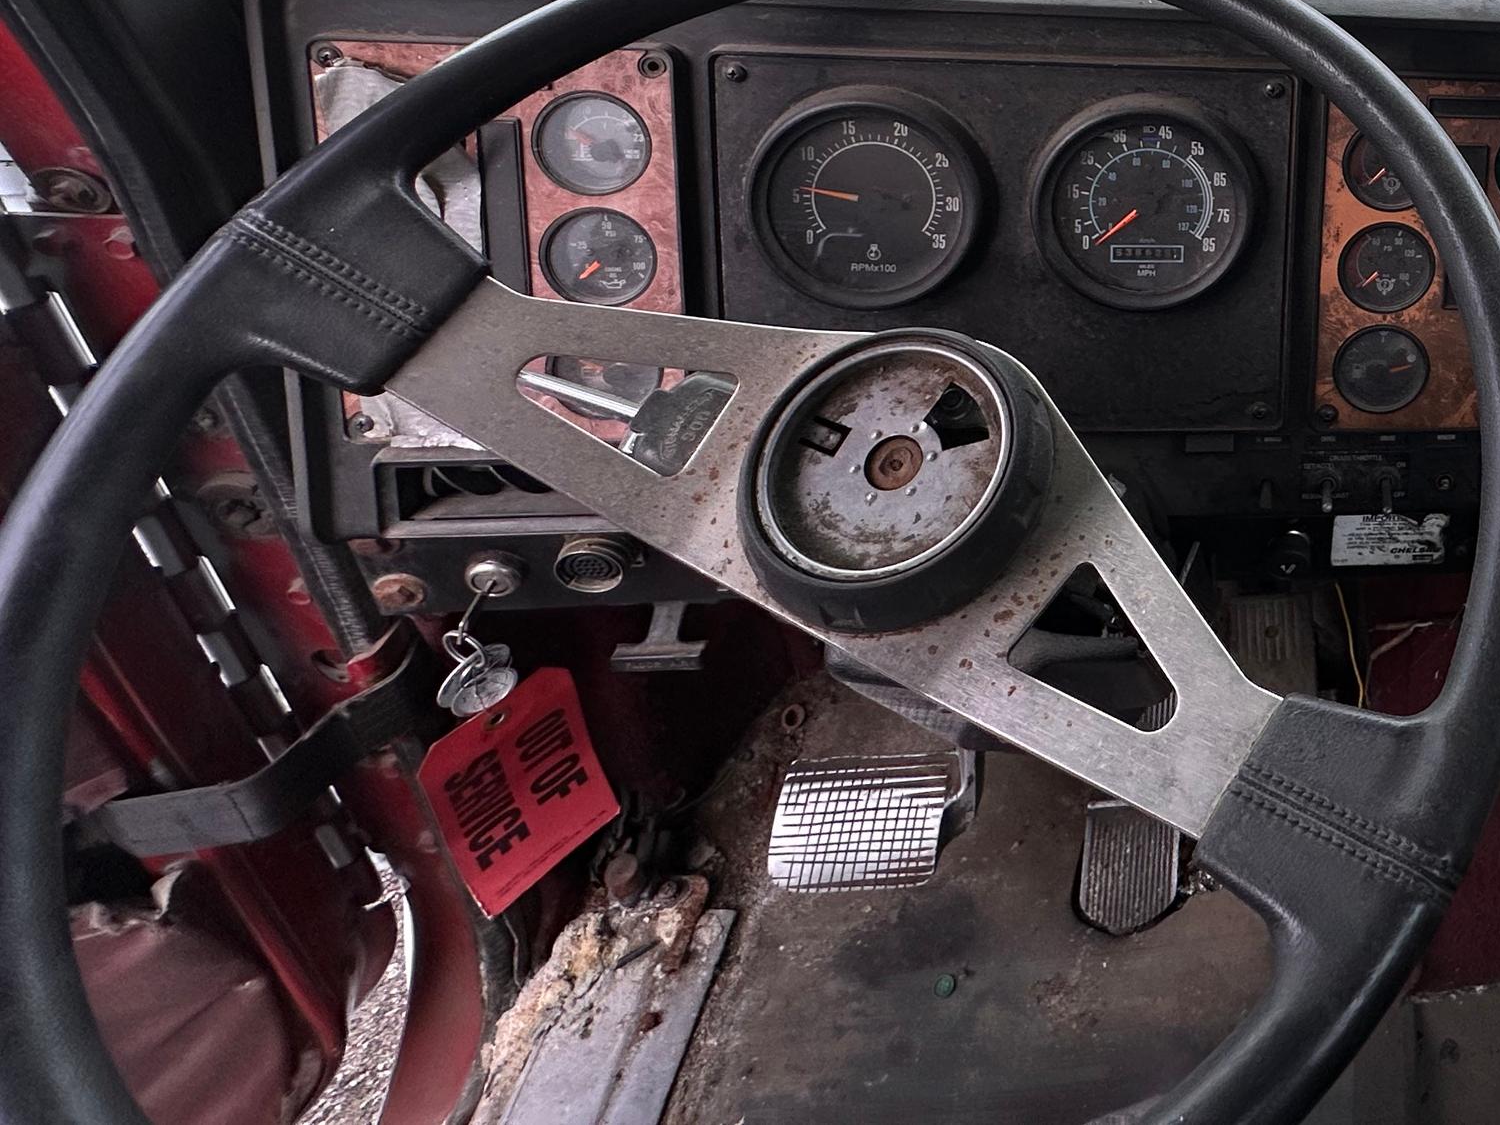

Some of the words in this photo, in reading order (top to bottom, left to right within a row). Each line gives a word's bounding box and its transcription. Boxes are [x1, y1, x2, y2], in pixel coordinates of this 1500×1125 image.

[841, 121, 856, 135] 15
[893, 122, 909, 137] 20
[1158, 125, 1172, 140] 45
[1113, 129, 1127, 143] 35
[800, 146, 815, 161] 10
[1190, 141, 1205, 156] 55
[935, 153, 949, 168] 25
[792, 188, 800, 203] 5
[945, 197, 960, 212] 30
[1217, 208, 1230, 223] 75
[1074, 220, 1082, 234] 5
[806, 230, 813, 244] 0
[932, 234, 946, 249] 35
[1082, 236, 1090, 250] 0
[1202, 237, 1216, 252] 85
[1136, 269, 1157, 277] MPH
[514, 708, 574, 774] OUT
[529, 753, 589, 806] OF
[443, 749, 531, 872] SERVICE
